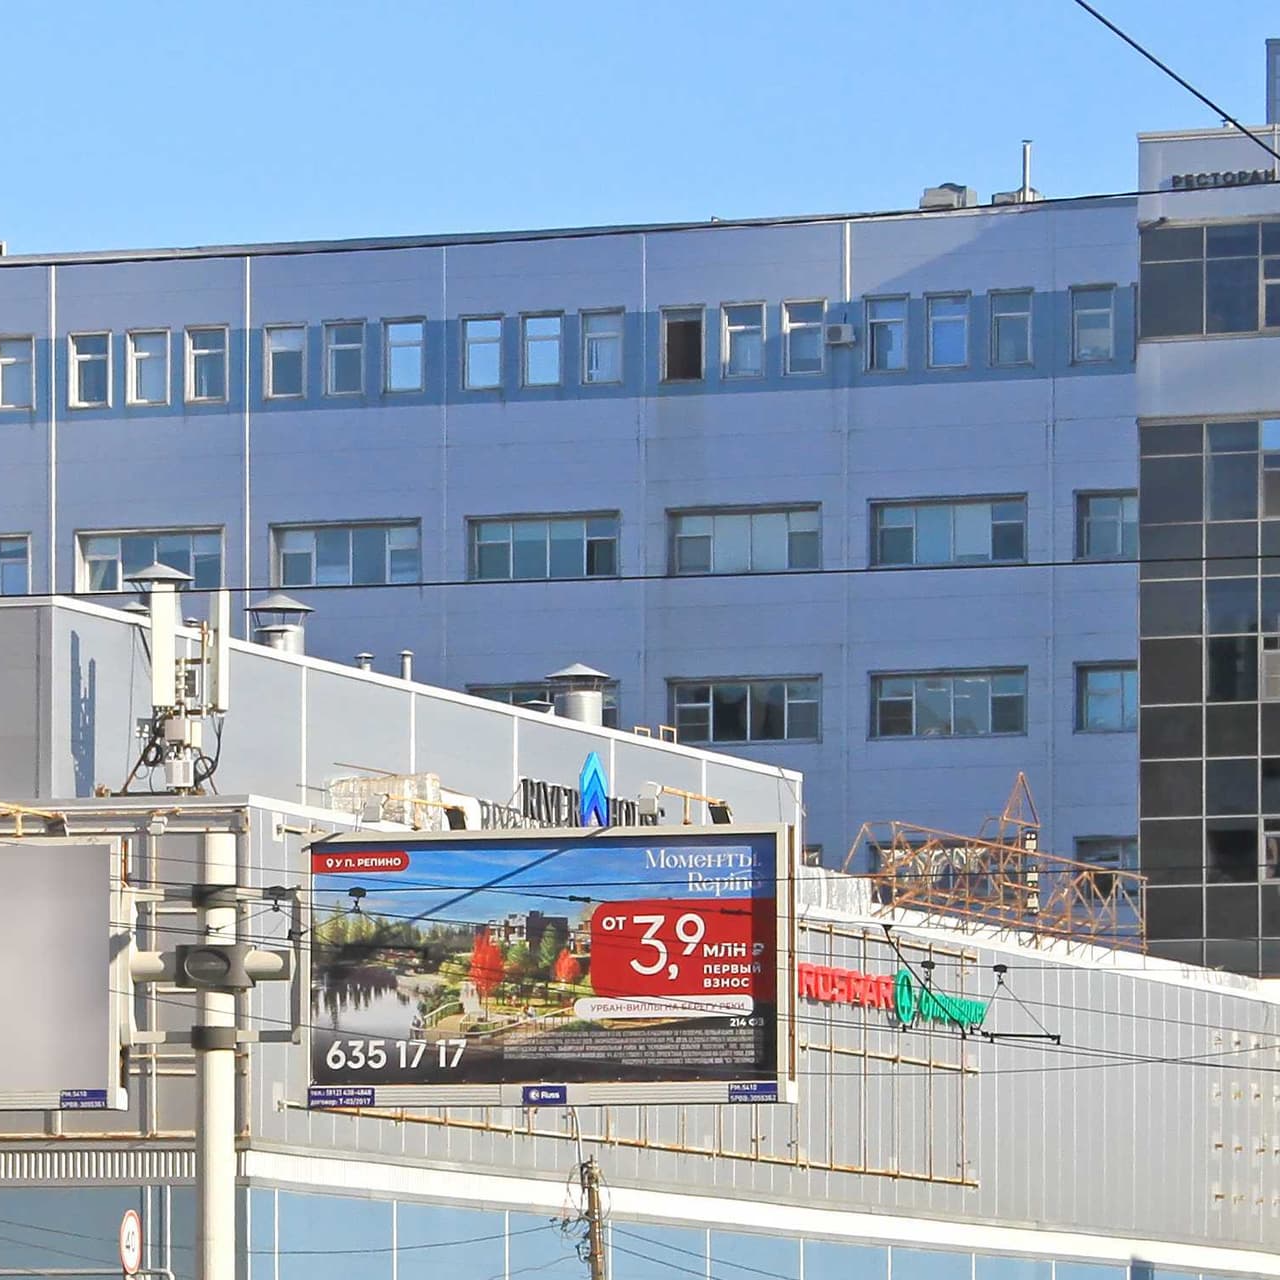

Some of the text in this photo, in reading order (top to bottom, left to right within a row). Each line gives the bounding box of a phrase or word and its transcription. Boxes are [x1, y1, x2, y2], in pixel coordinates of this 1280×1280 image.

[519, 778, 583, 827] RIVER
[357, 857, 402, 867] РЕПИНО
[630, 913, 706, 980] 3,9
[590, 1003, 662, 1012] УРБАН-ВИЛЛЫ
[730, 1018, 746, 1027] 214
[326, 1038, 467, 1069] 635 17 17
[541, 1091, 560, 1099] Russ
[125, 1232, 135, 1252] 40
